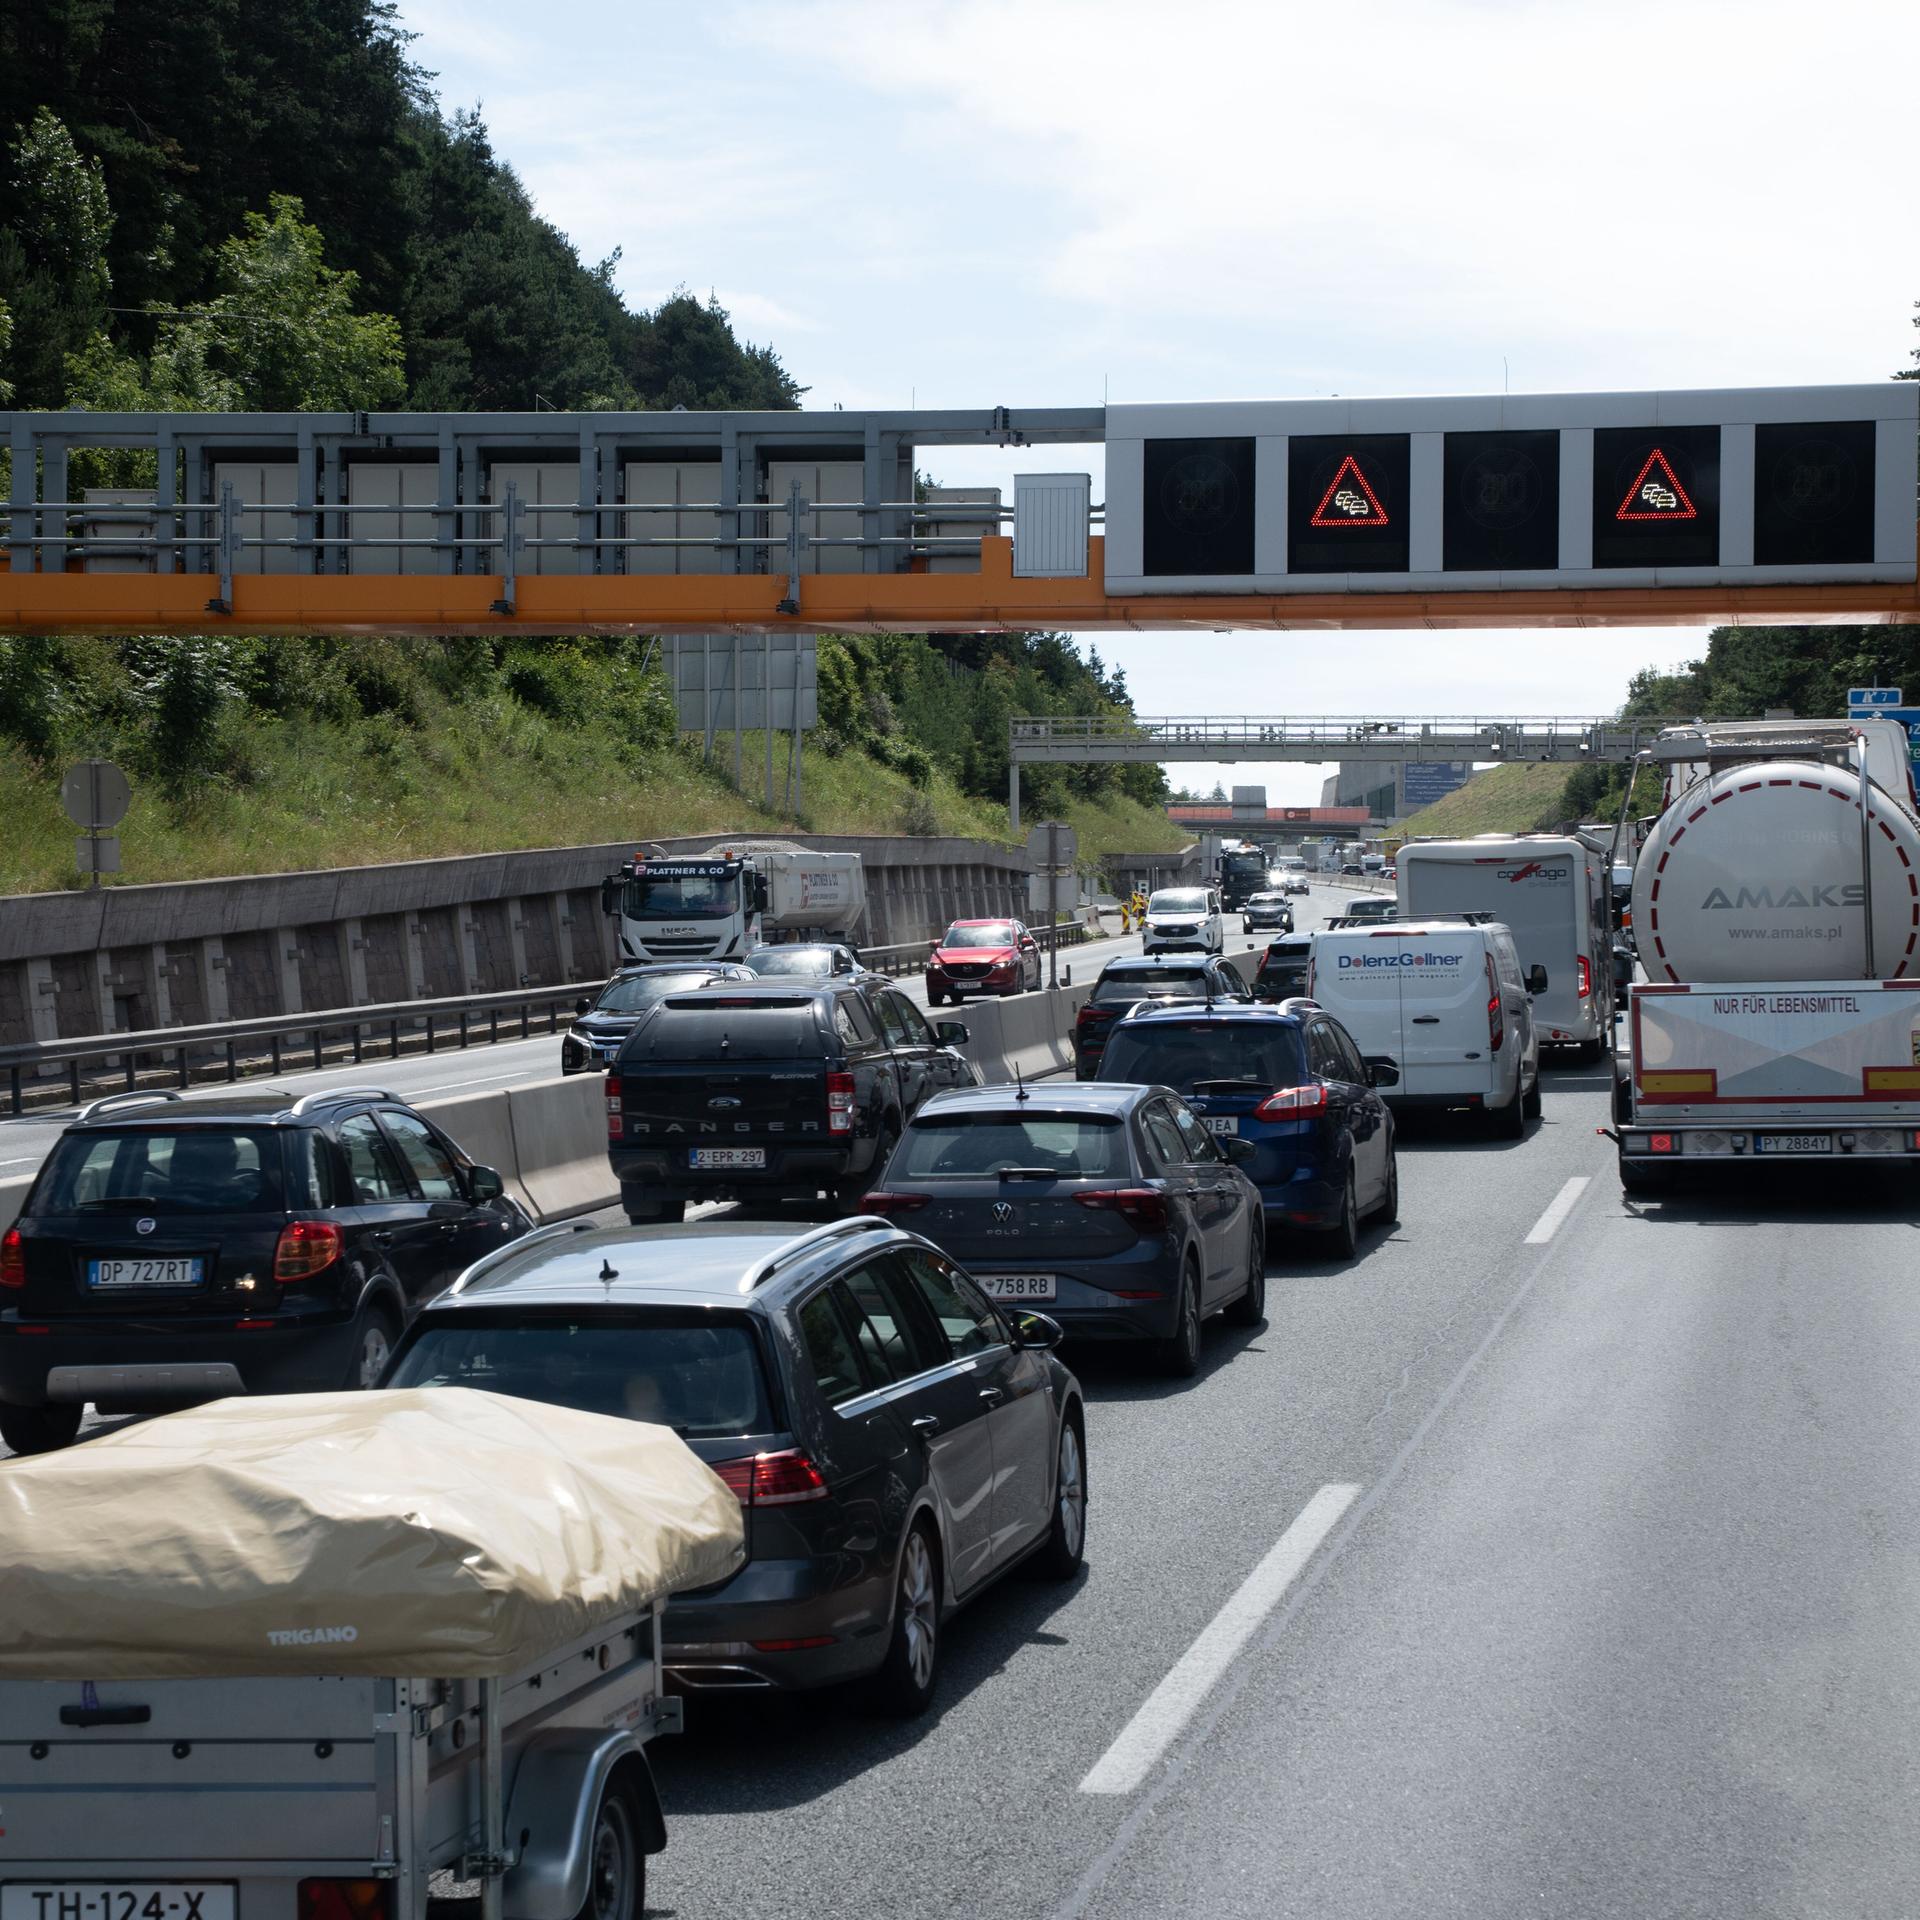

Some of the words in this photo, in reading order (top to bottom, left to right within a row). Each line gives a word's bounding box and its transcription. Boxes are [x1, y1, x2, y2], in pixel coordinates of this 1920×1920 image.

[1881, 692, 1888, 702] 7
[647, 867, 697, 875] PLATTNER
[698, 867, 707, 875] &
[709, 866, 724, 875] CO
[1701, 884, 1866, 909] AMAKS
[661, 927, 697, 936] IVECO
[1728, 925, 1843, 941] www.amaks.pl
[1713, 998, 1739, 1014] NUR
[1742, 995, 1766, 1014] FÜR
[1770, 997, 1860, 1013] LEBENSMITTEL
[633, 1121, 819, 1133] RANGER
[1215, 1119, 1232, 1132] EA
[1763, 1137, 1780, 1150] PY
[1786, 1137, 1827, 1150] 2884Y
[996, 1278, 1025, 1294] 758
[1028, 1278, 1048, 1294] RB
[267, 1625, 358, 1647] TRIGANO
[32, 1891, 206, 1920] TH-124-X
